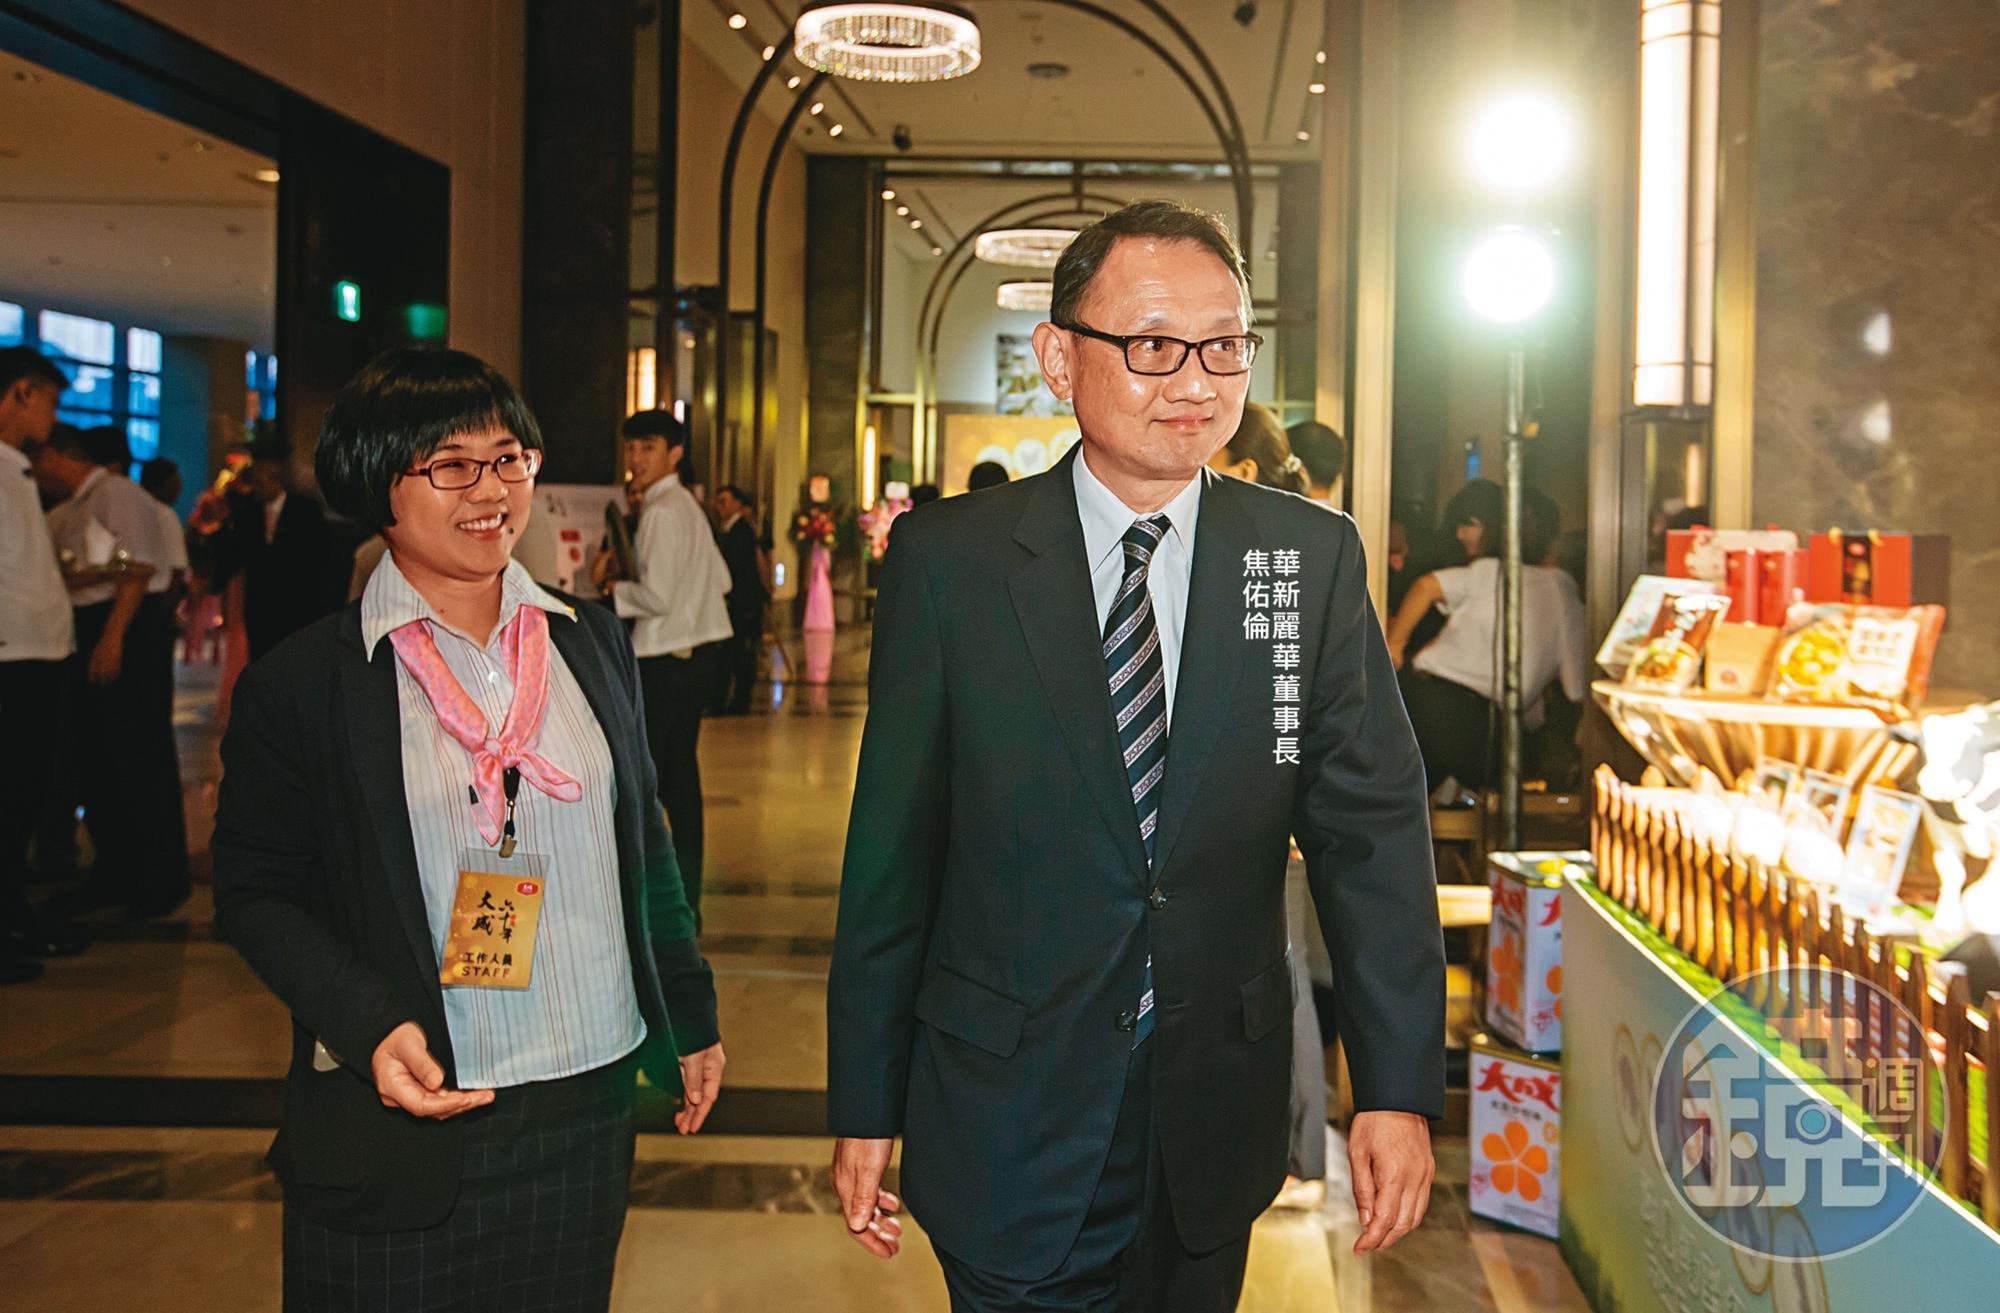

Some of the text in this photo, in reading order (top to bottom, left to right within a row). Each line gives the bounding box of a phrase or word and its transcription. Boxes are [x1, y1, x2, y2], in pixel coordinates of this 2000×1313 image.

[463, 952, 512, 966] 工作人員
[462, 966, 511, 978] STAFF
